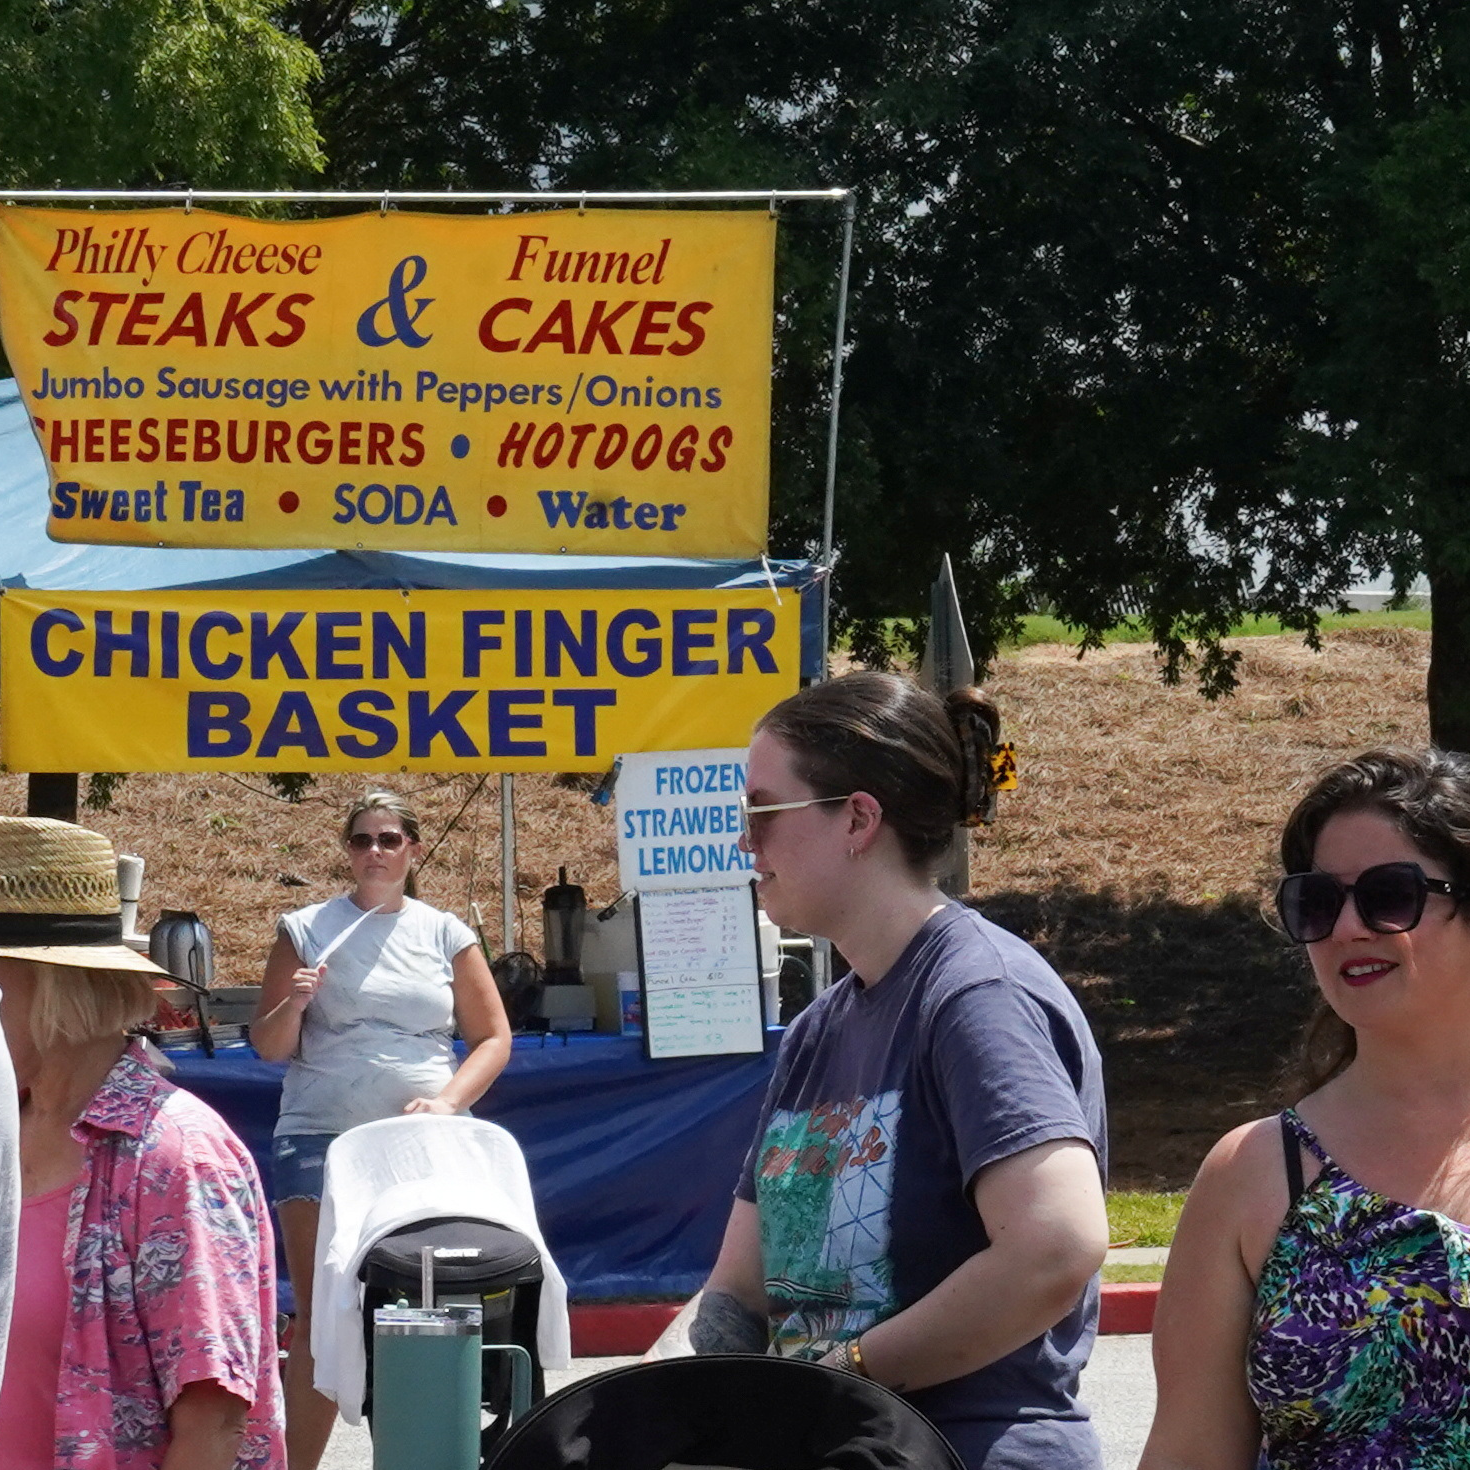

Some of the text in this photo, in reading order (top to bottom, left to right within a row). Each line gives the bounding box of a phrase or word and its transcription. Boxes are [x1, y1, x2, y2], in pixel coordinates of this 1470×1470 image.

[46, 227, 321, 286] Philly Cheese
[508, 236, 671, 284] Funnel
[43, 254, 713, 356] STEAKS & CAKES
[32, 366, 722, 413] Jumbo Sausage with Peppers/Onions
[498, 422, 732, 472] HOTDOGS
[51, 482, 687, 532] Sweet Tea SODA Water
[32, 610, 776, 679] CHICKEN FINGER
[189, 691, 614, 757] BASKET
[624, 803, 746, 840] STRAWBE
